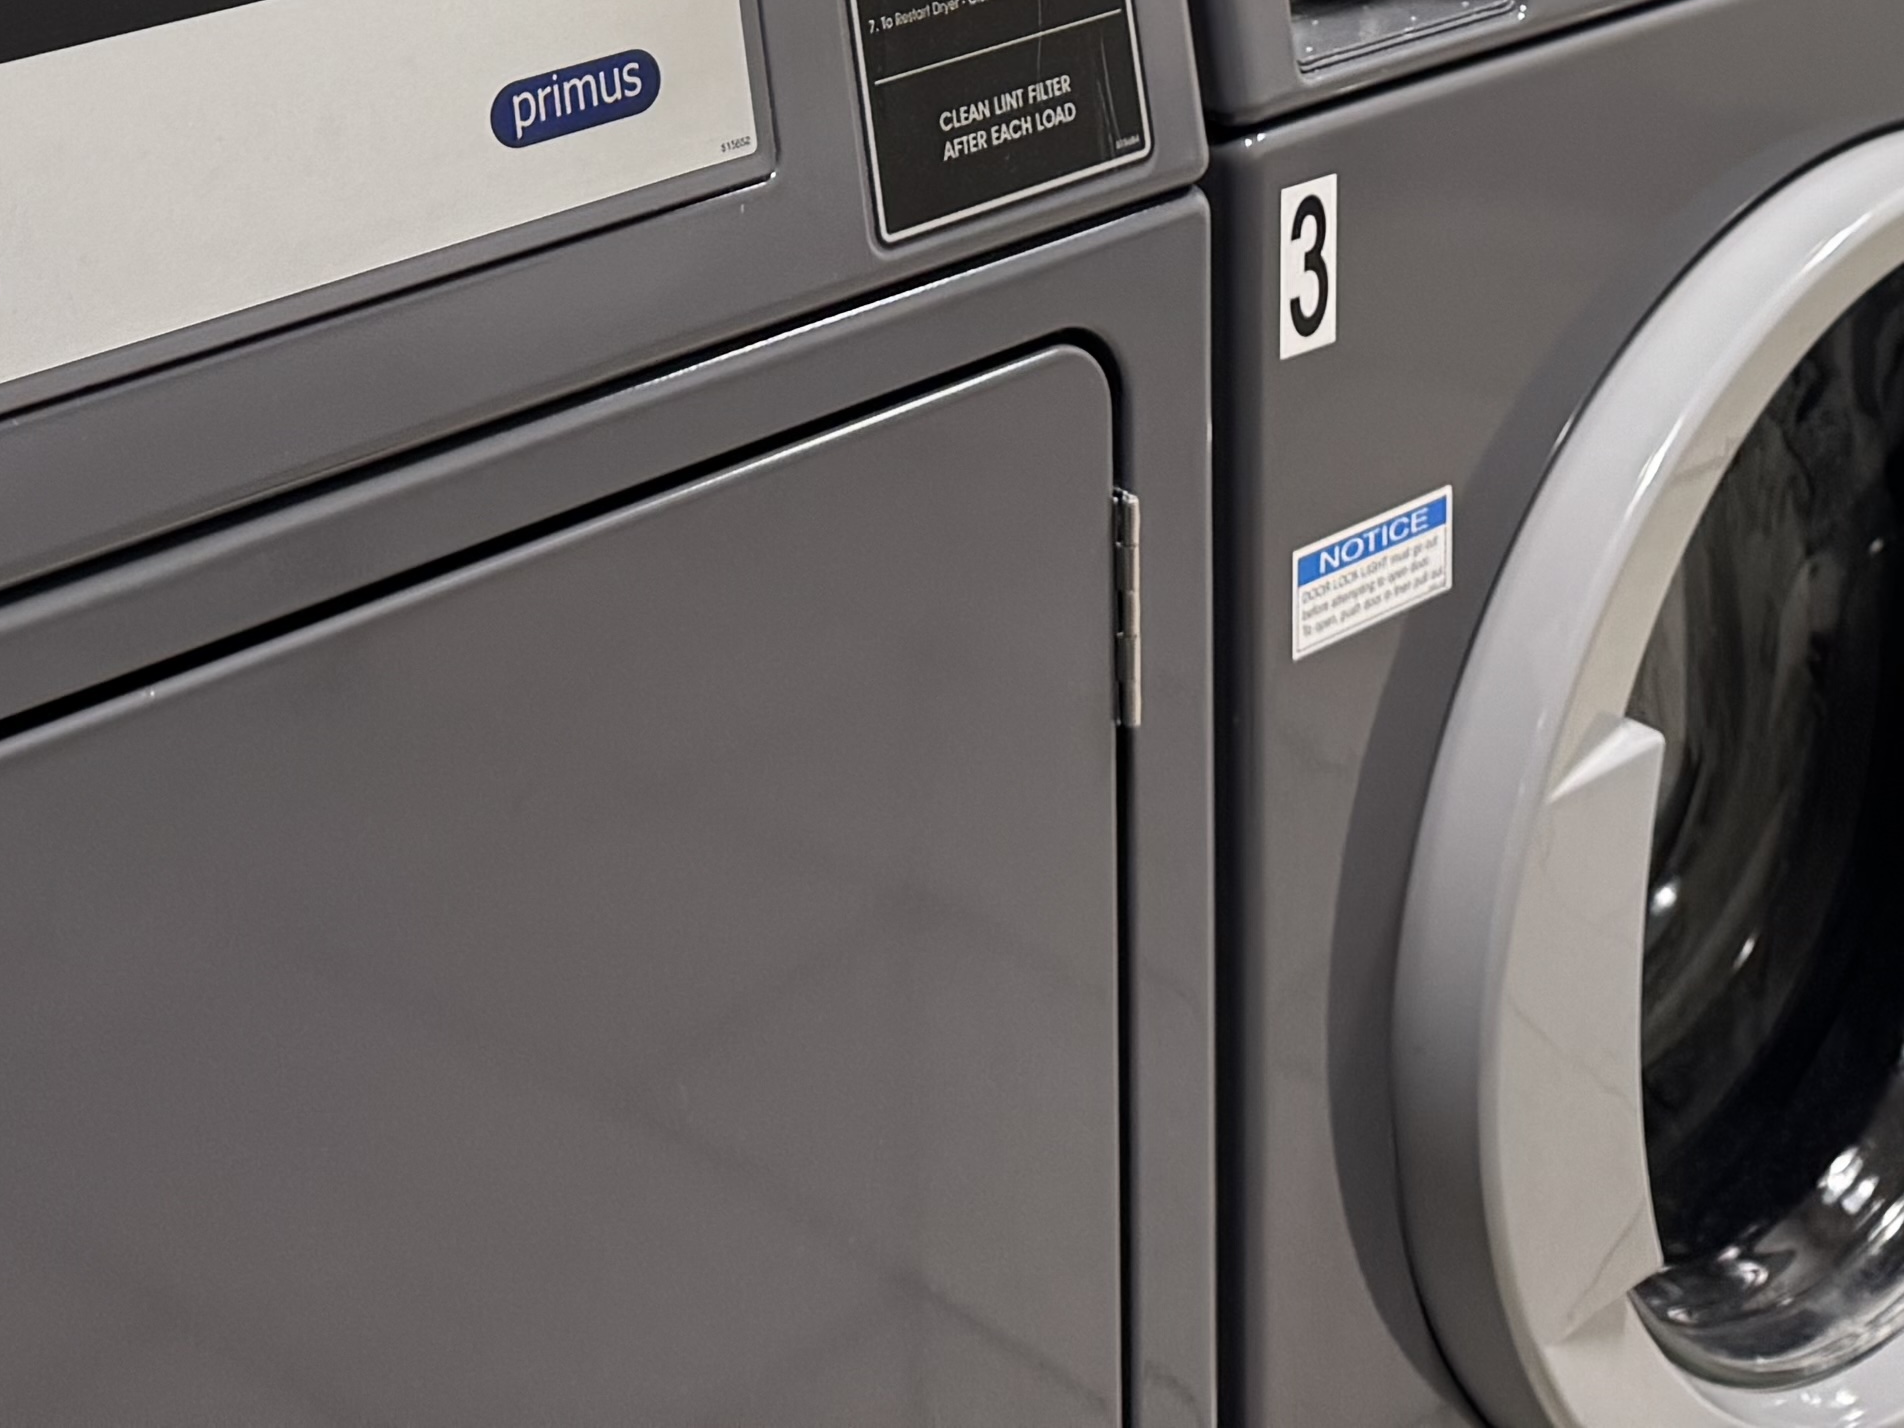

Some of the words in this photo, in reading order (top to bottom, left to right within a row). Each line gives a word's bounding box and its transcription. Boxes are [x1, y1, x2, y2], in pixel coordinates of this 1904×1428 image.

[868, 19, 880, 34] 7.
[880, 14, 894, 30] To
[895, 2, 931, 27] Restart
[511, 61, 643, 141] primus
[939, 98, 991, 132] CLEAN
[992, 87, 1024, 115] LINT
[1027, 74, 1072, 105] FILTER
[943, 129, 988, 162] AFTER
[990, 115, 1034, 146] EACH
[1035, 101, 1077, 132] LOAD
[1289, 194, 1328, 338] 3
[1319, 506, 1430, 576] NOTICE
